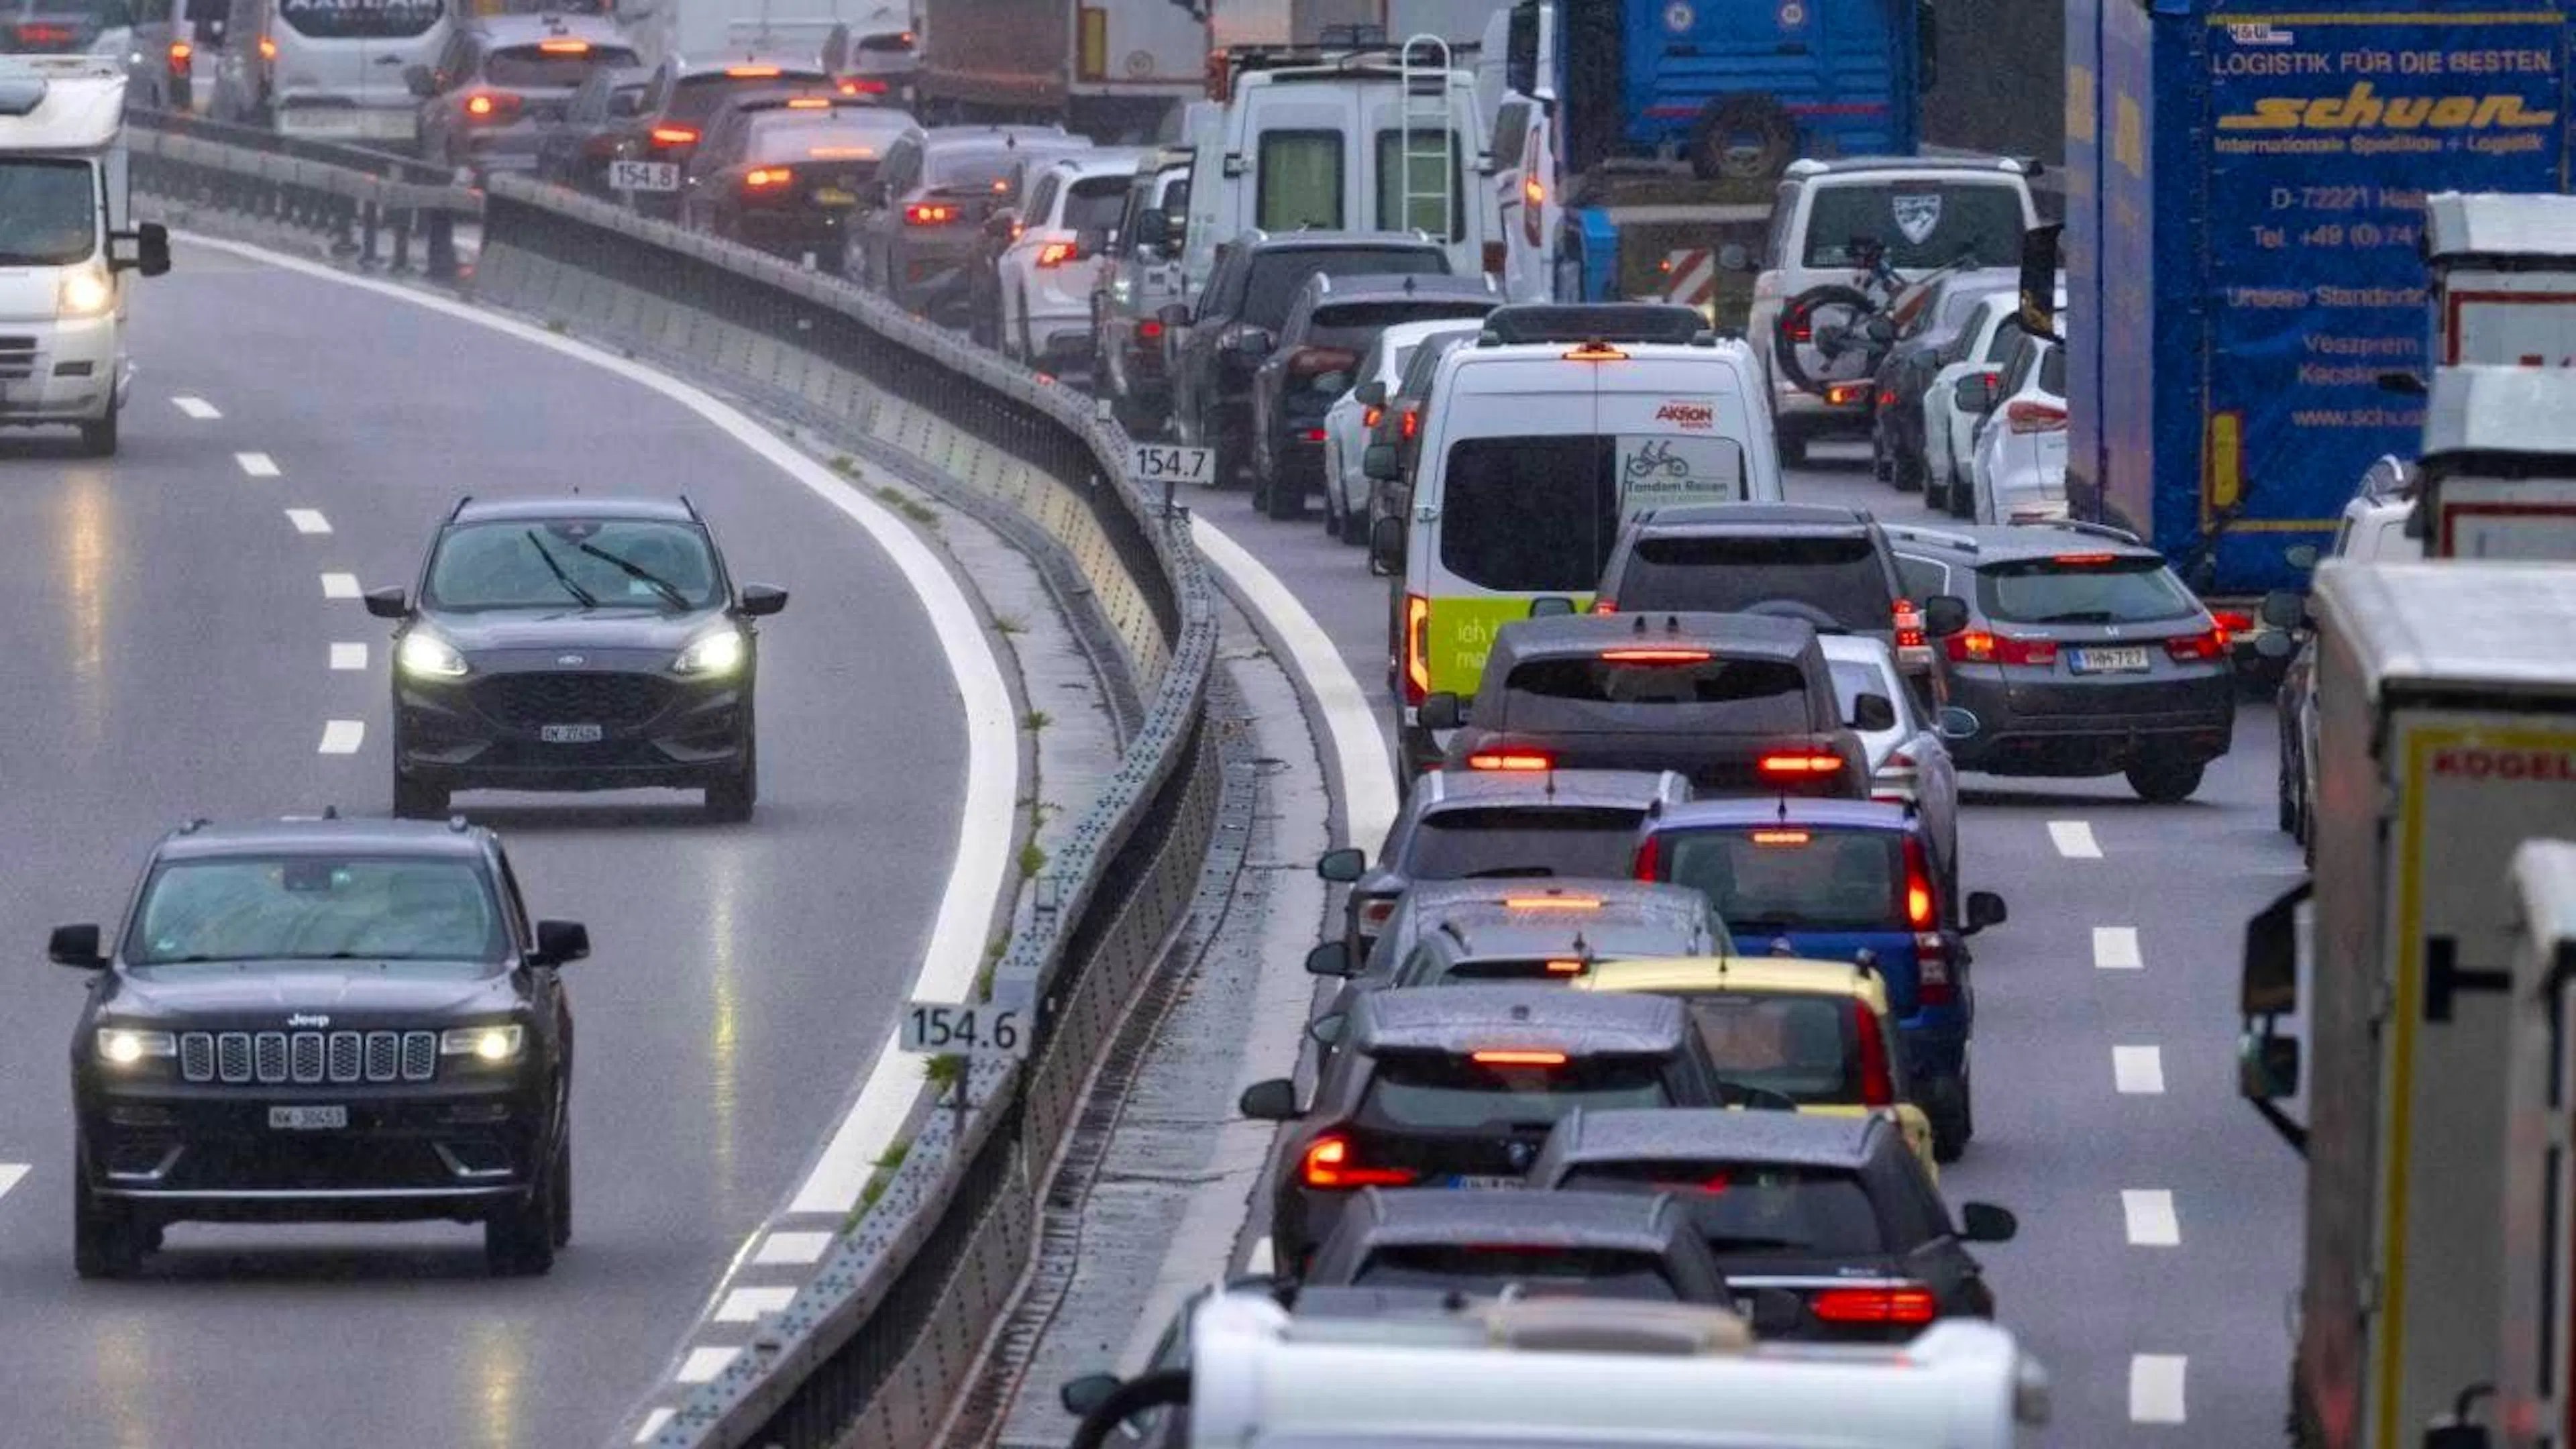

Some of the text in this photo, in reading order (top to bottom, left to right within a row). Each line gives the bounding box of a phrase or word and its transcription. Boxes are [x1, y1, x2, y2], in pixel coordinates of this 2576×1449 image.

[2214, 47, 2552, 75] LOGISTIK FÜR DIE BESTEN
[2467, 133, 2544, 155] Logistik
[617, 164, 672, 186] 154.8
[1136, 448, 1206, 477] 154.7
[912, 1007, 1016, 1049] 154.6
